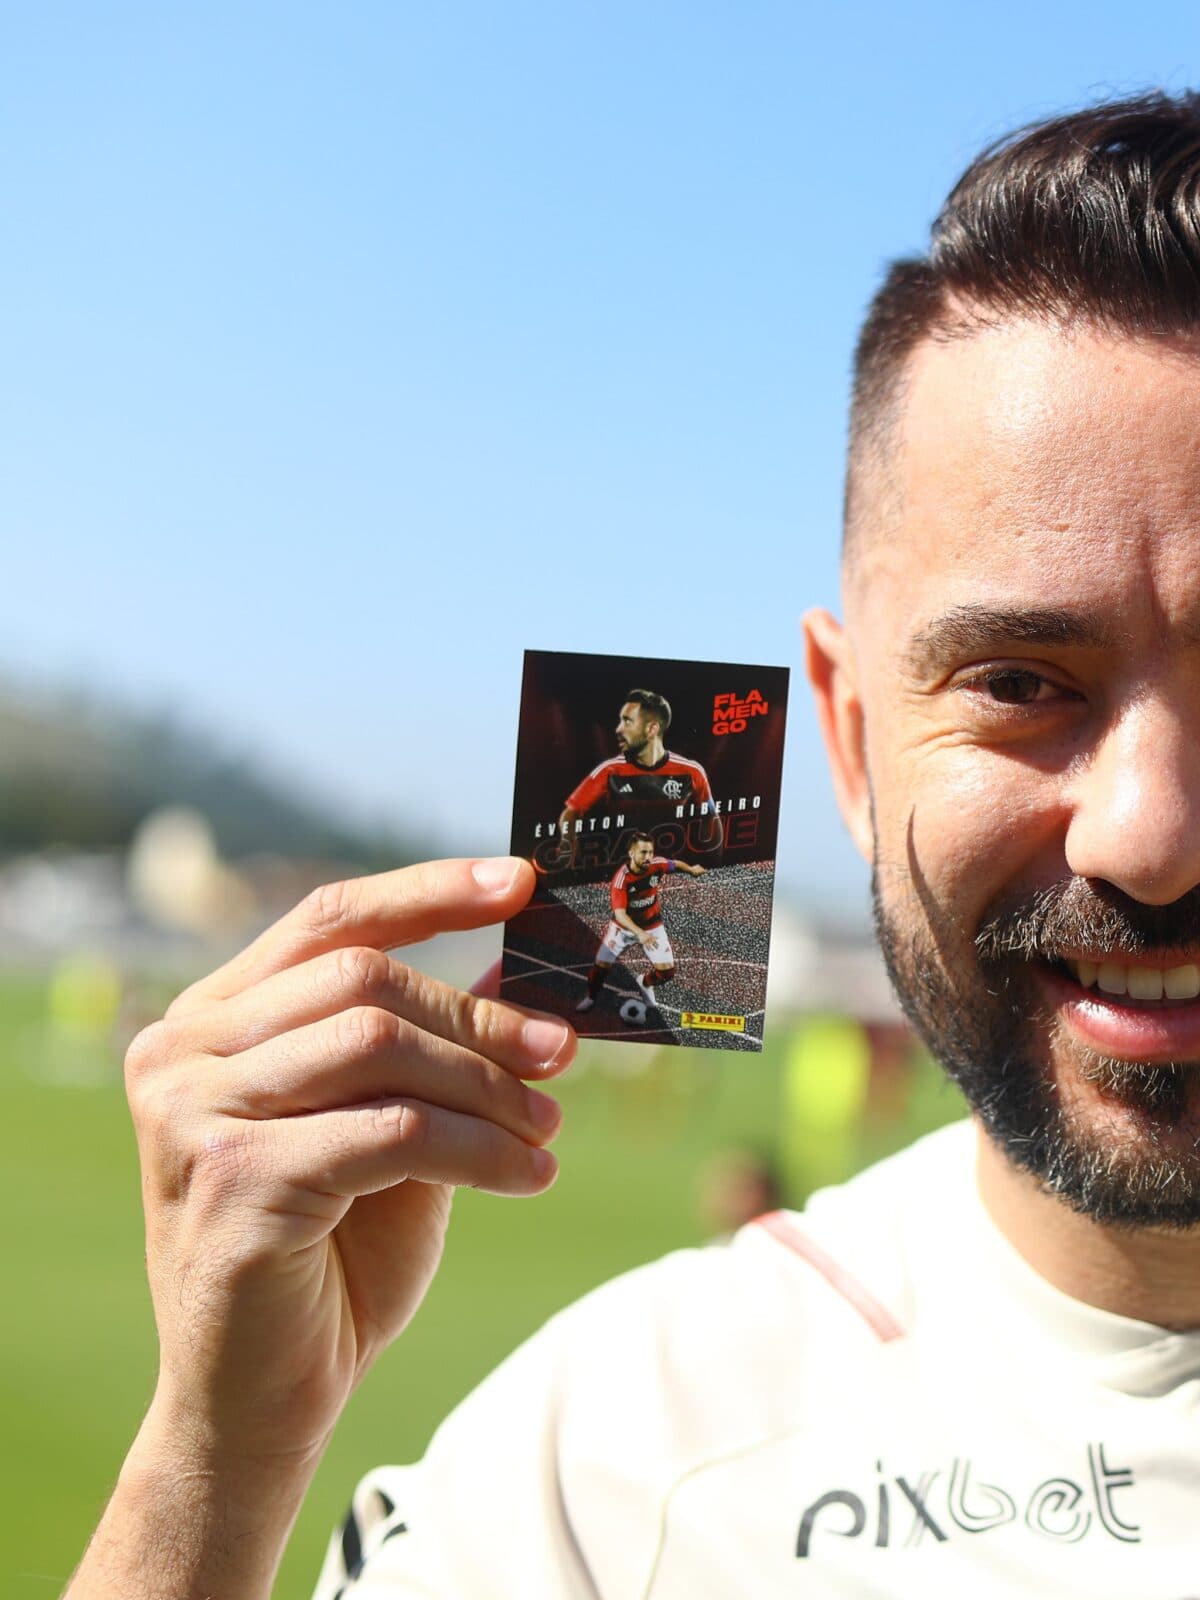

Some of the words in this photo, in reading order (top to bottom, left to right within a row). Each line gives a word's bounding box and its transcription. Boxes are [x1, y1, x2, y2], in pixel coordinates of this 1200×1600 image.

[714, 688, 762, 708] FLA
[713, 701, 769, 722] MEN
[712, 719, 747, 736] GO
[535, 814, 625, 838] ÉVERTON
[675, 796, 761, 818] RIBEIRO
[699, 1015, 742, 1026] PANINI
[795, 1442, 1142, 1559] pixbet
